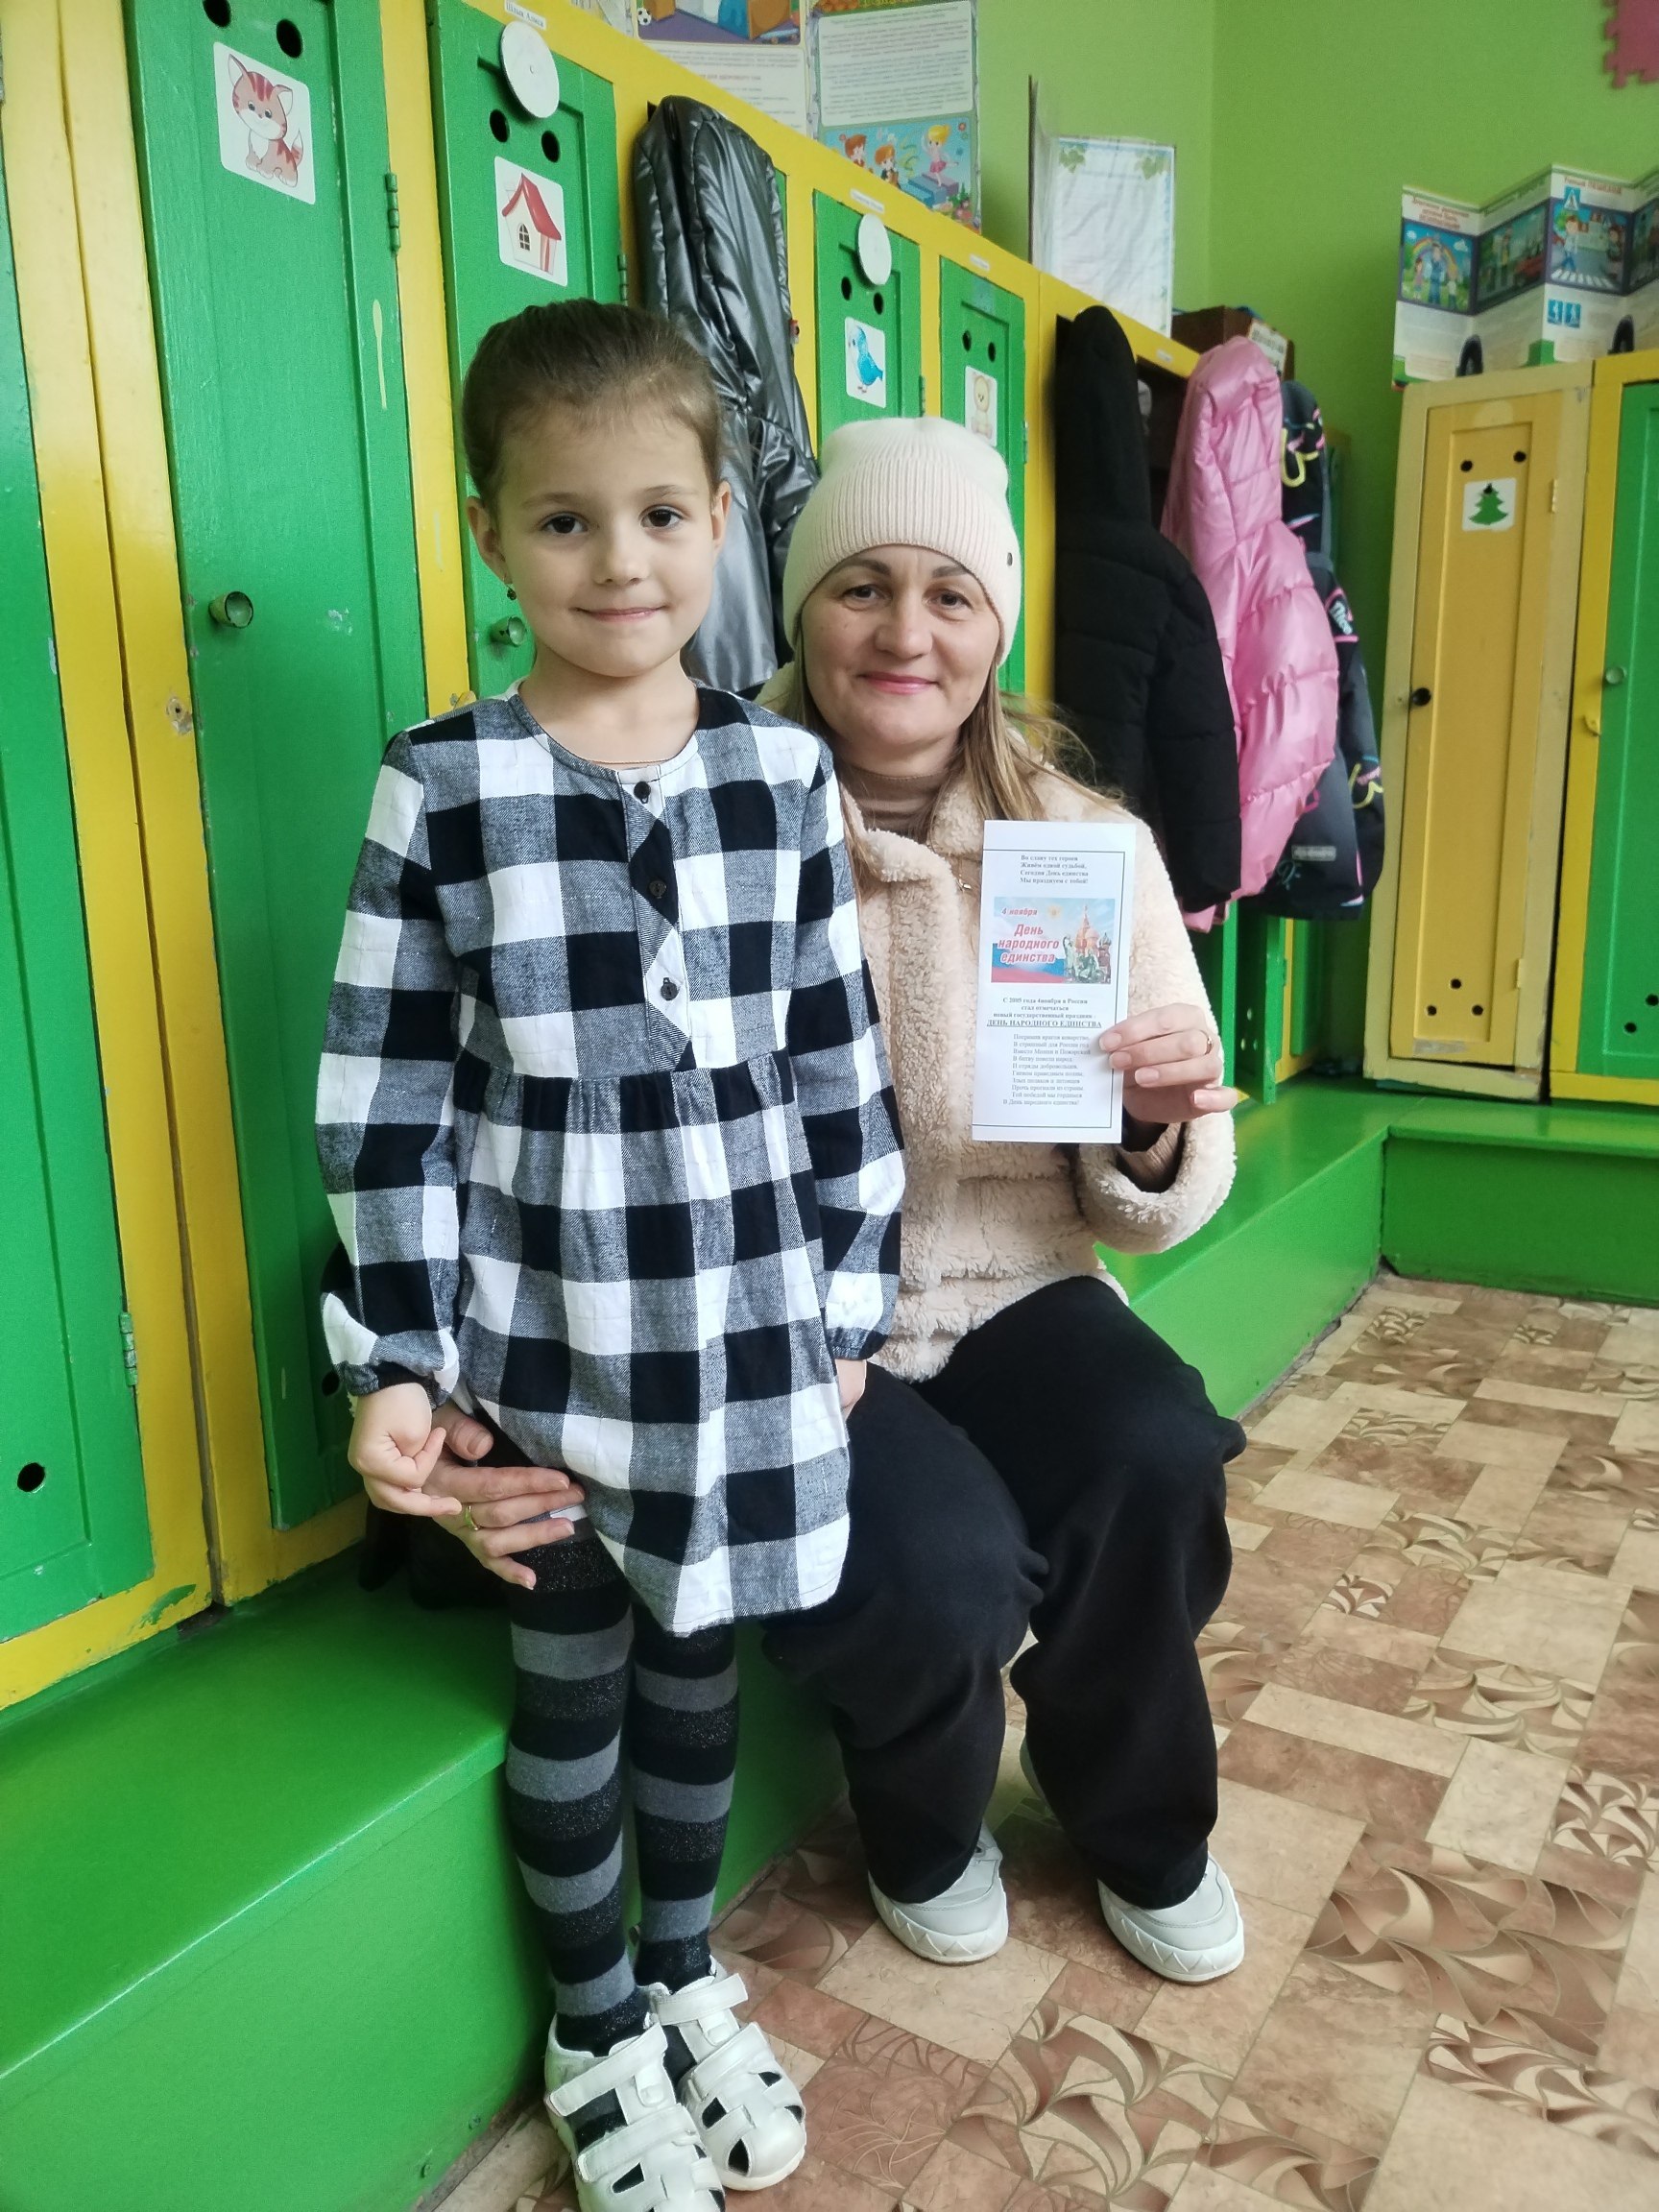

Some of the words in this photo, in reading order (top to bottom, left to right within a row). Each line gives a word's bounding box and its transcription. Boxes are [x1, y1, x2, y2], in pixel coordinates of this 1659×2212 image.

[1009, 908, 1038, 916] ноября
[1014, 924, 1044, 937] День
[998, 939, 1060, 950] народного
[1001, 952, 1055, 962] единства
